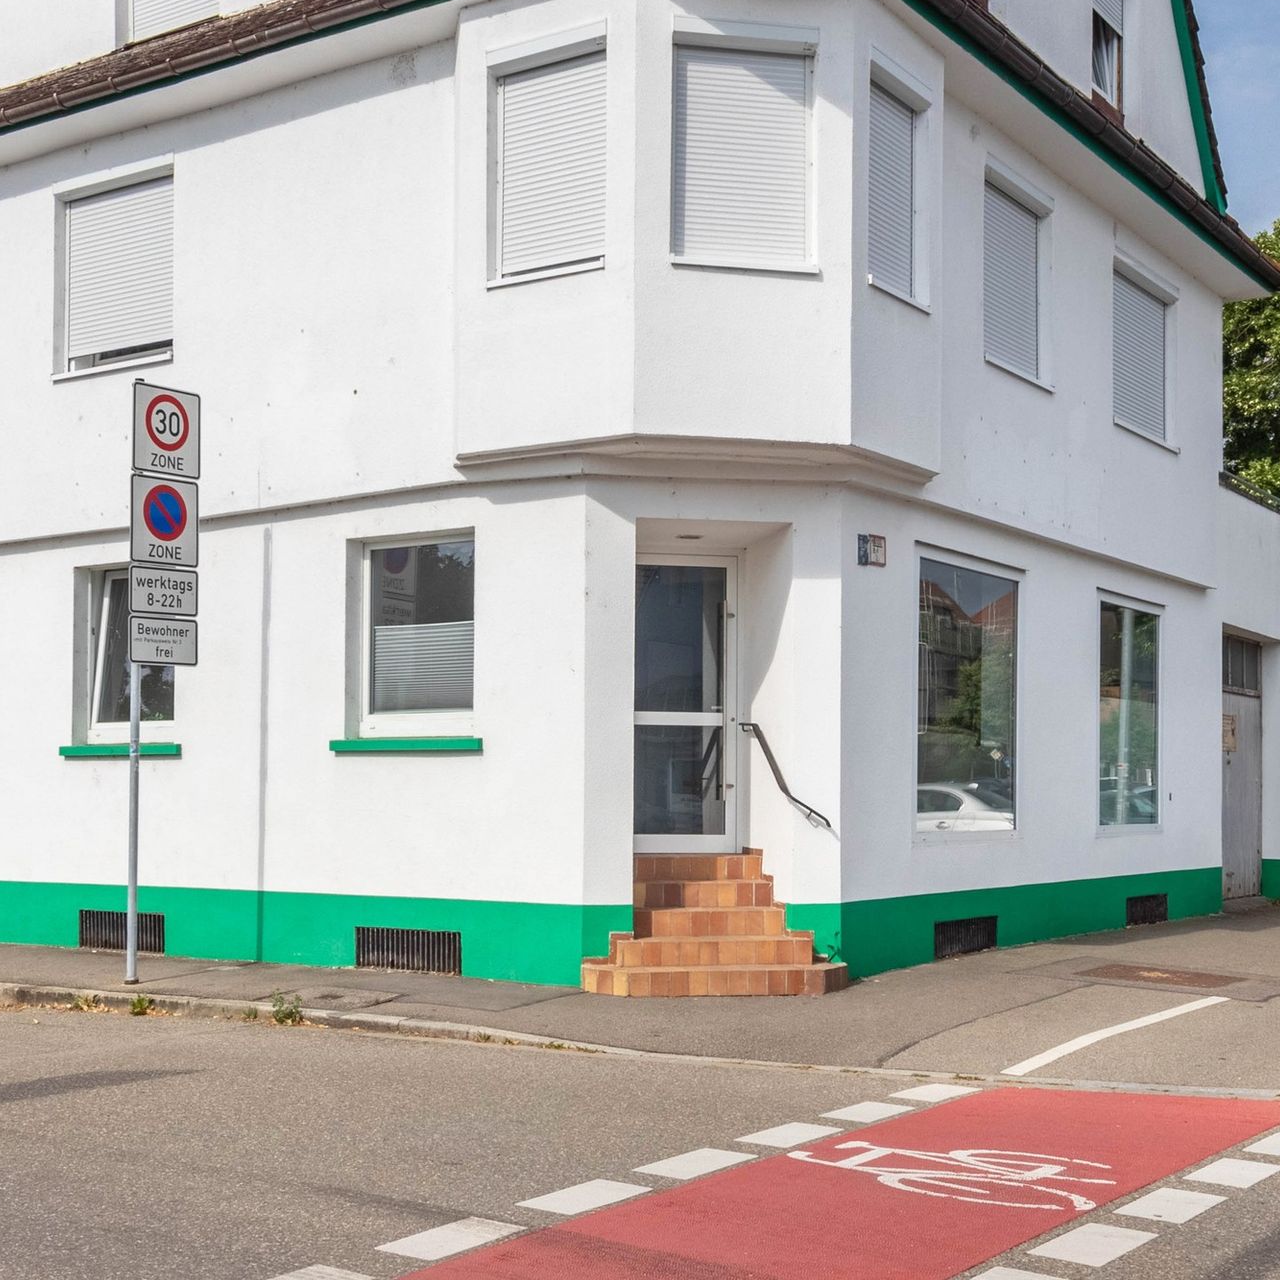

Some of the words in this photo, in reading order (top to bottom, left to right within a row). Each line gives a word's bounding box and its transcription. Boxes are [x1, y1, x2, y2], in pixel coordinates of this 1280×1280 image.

[155, 409, 180, 437] 30
[151, 452, 184, 471] ZONE
[148, 543, 182, 560] ZONE
[136, 576, 193, 595] werktags
[137, 623, 190, 637] Bewohner
[155, 646, 173, 658] frei
